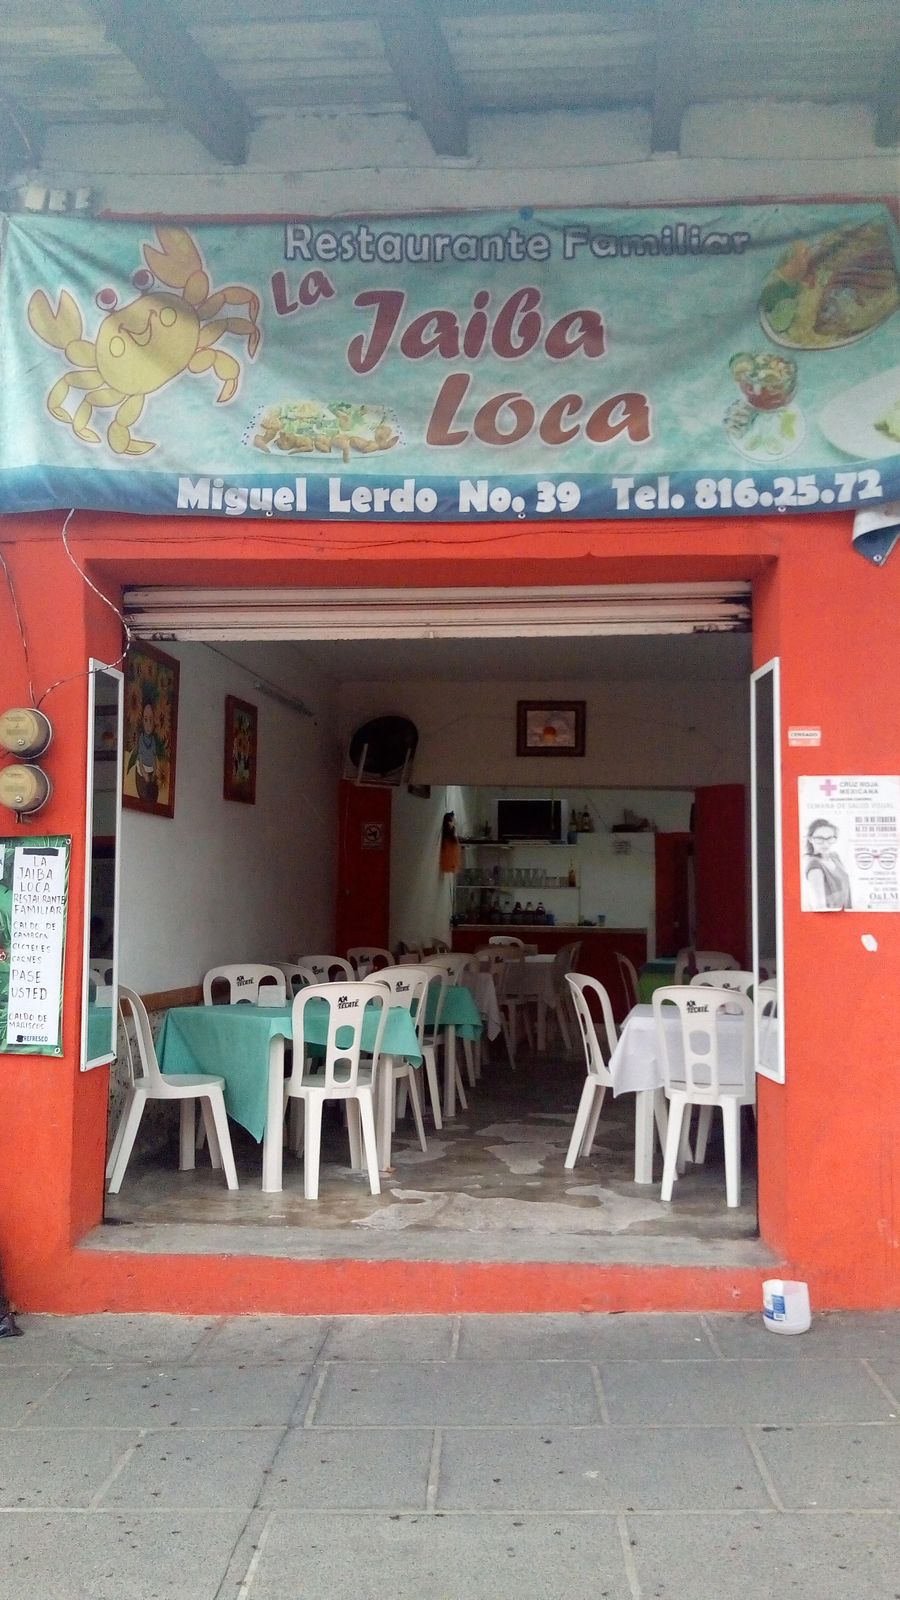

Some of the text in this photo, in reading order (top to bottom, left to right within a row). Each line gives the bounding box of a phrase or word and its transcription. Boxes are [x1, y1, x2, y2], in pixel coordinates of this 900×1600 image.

[284, 222, 752, 262] Restaurante Familiar
[271, 270, 335, 315] La
[348, 286, 606, 374] Jaiba
[426, 373, 651, 446] Loca
[177, 469, 883, 515] Miguel Lerdo No. 39 Tel. 816.25.72
[33, 856, 47, 867] LA
[18, 867, 53, 881] JAIBA
[20, 882, 51, 893] LOCA
[15, 904, 62, 914] FAMILIAR
[46, 923, 56, 931] DE
[12, 969, 41, 983] PASE
[236, 977, 254, 987] TECATE
[11, 987, 47, 1000] USTED
[338, 999, 360, 1009] TECATE
[687, 1004, 710, 1013] TECATE
[38, 1014, 47, 1022] DE
